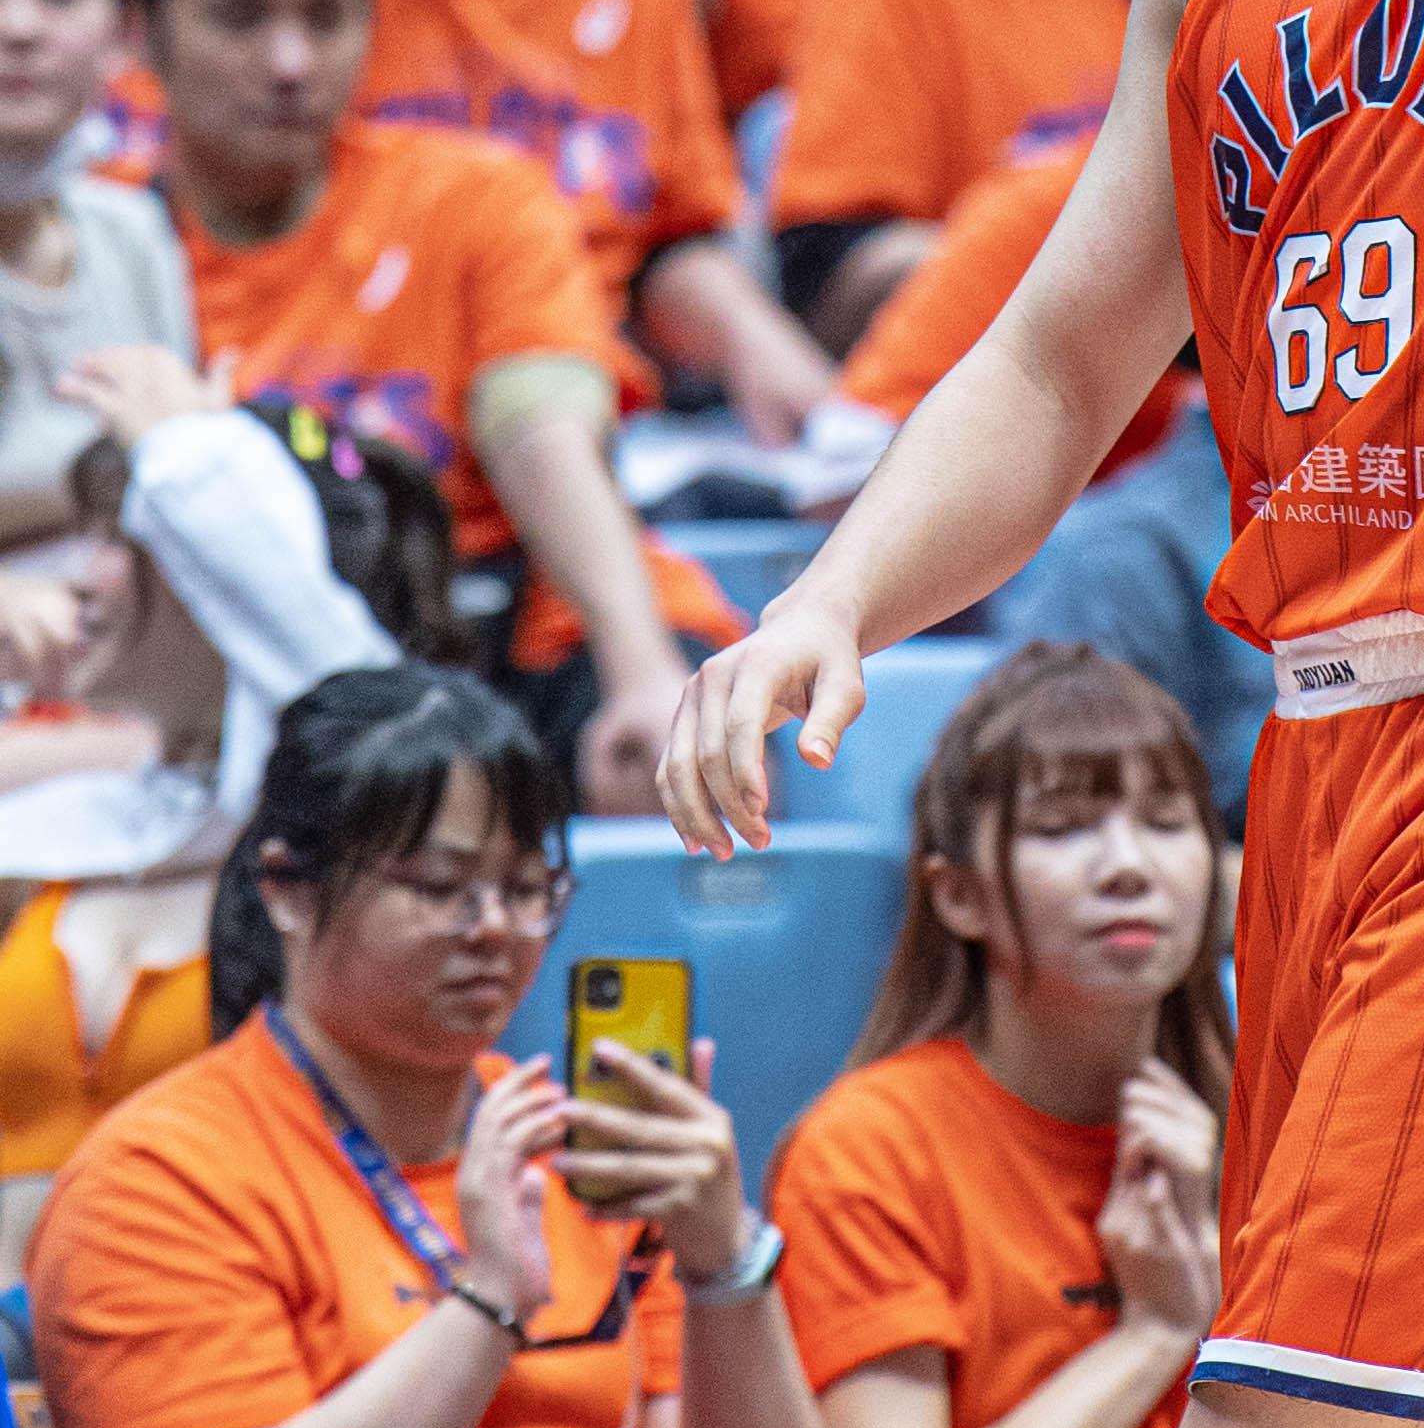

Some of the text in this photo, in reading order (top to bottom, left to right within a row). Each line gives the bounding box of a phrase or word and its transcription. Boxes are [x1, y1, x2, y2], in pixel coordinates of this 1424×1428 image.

[1267, 215, 1417, 416] 69
[1285, 502, 1414, 531] ARCHILAND
[1291, 659, 1356, 692] TAOYUAN
